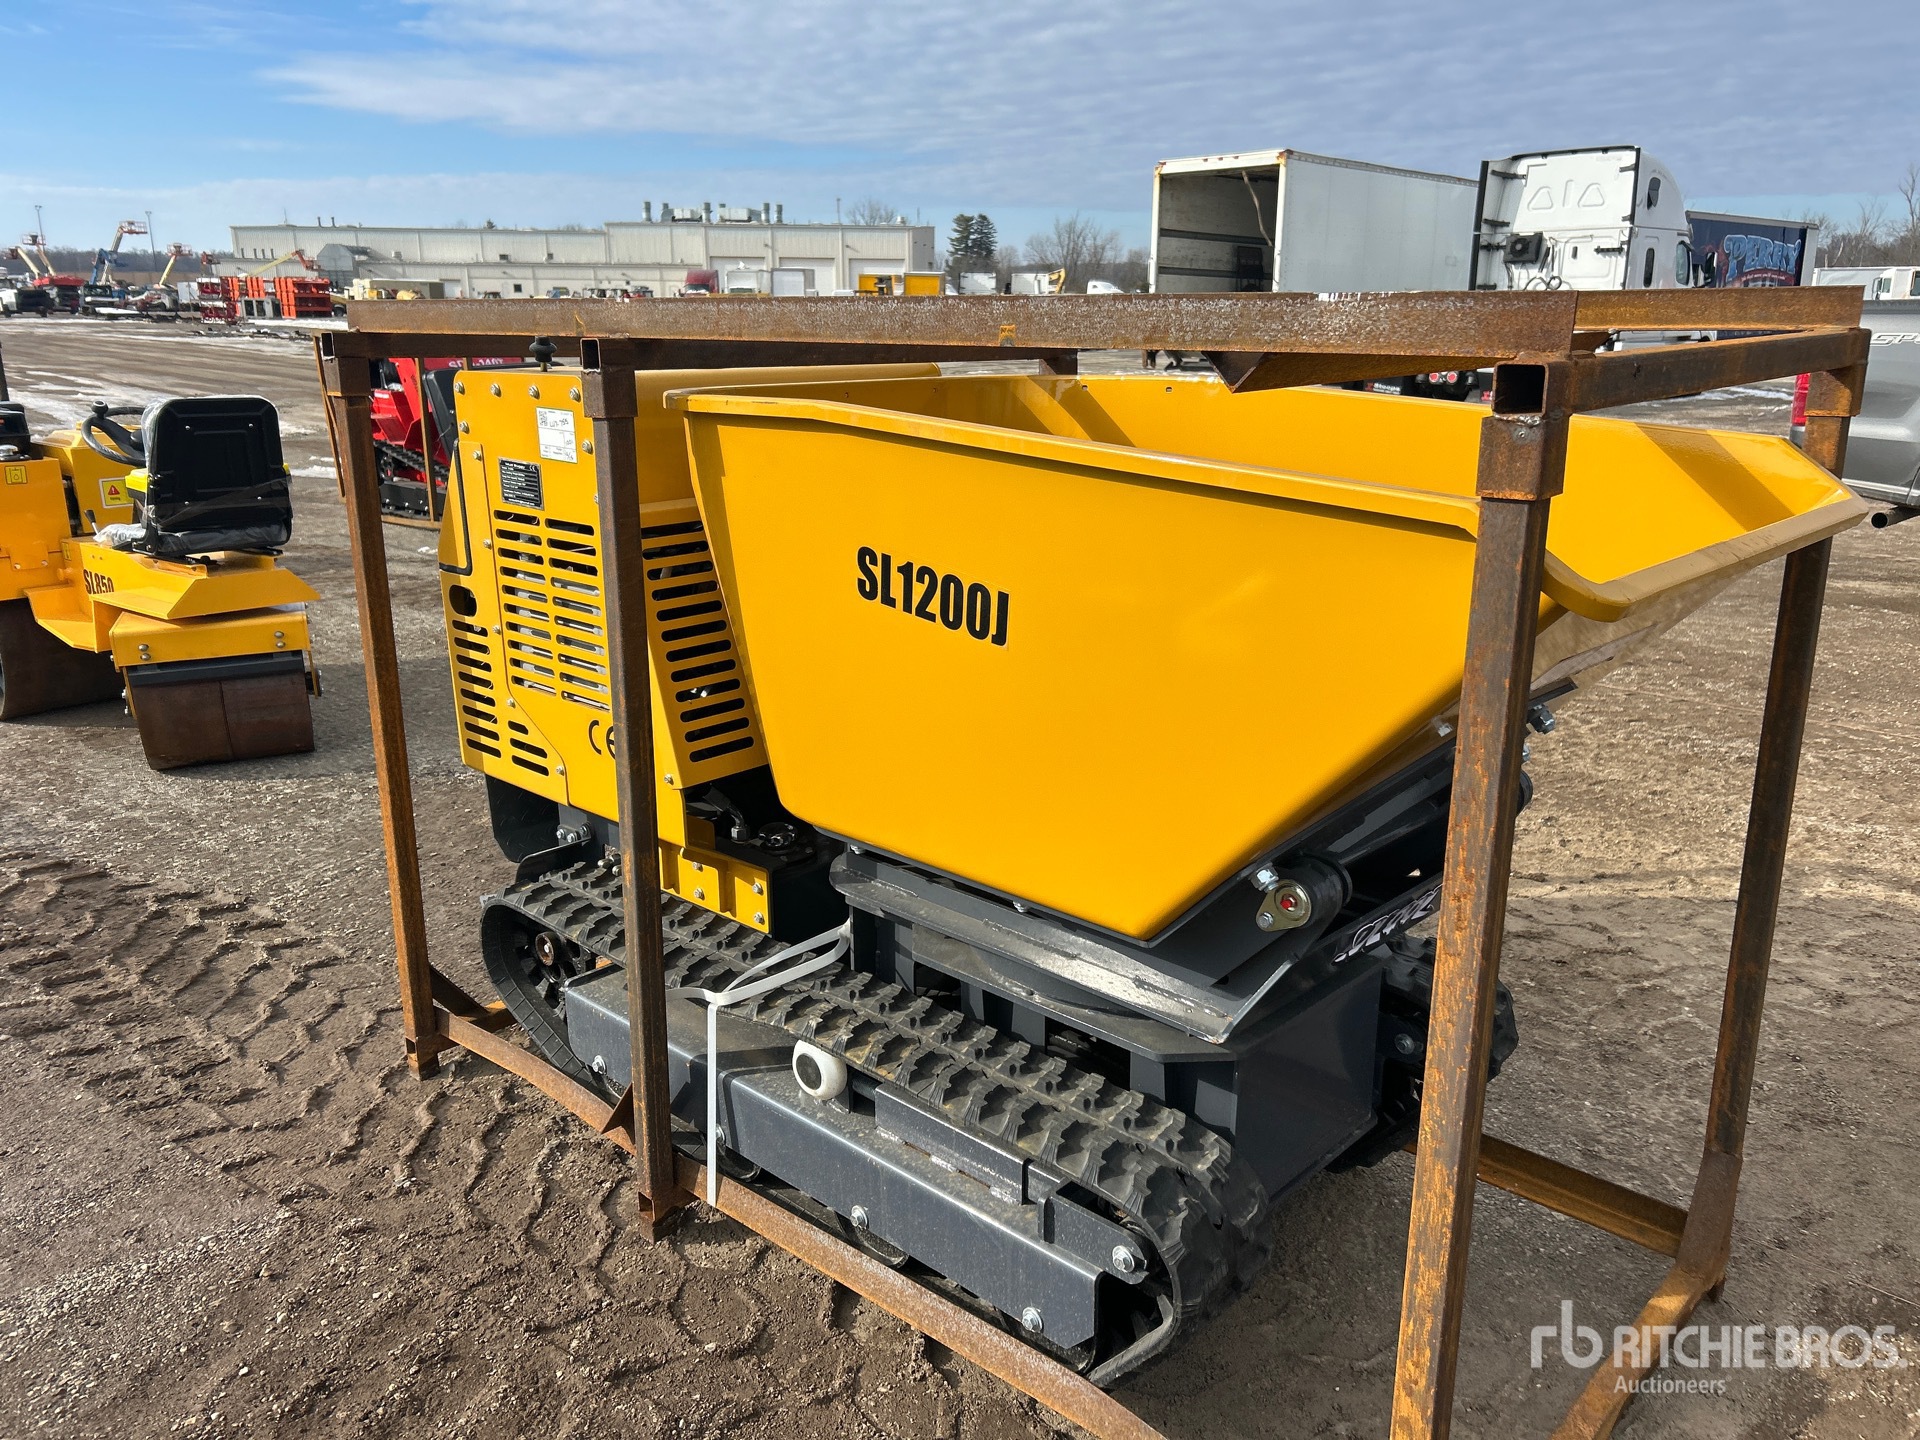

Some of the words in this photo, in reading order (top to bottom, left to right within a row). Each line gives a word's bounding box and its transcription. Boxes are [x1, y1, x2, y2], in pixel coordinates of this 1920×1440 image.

[1723, 234, 1802, 283] PERRY
[83, 568, 115, 595] SL850
[857, 546, 1010, 647] SL1200J
